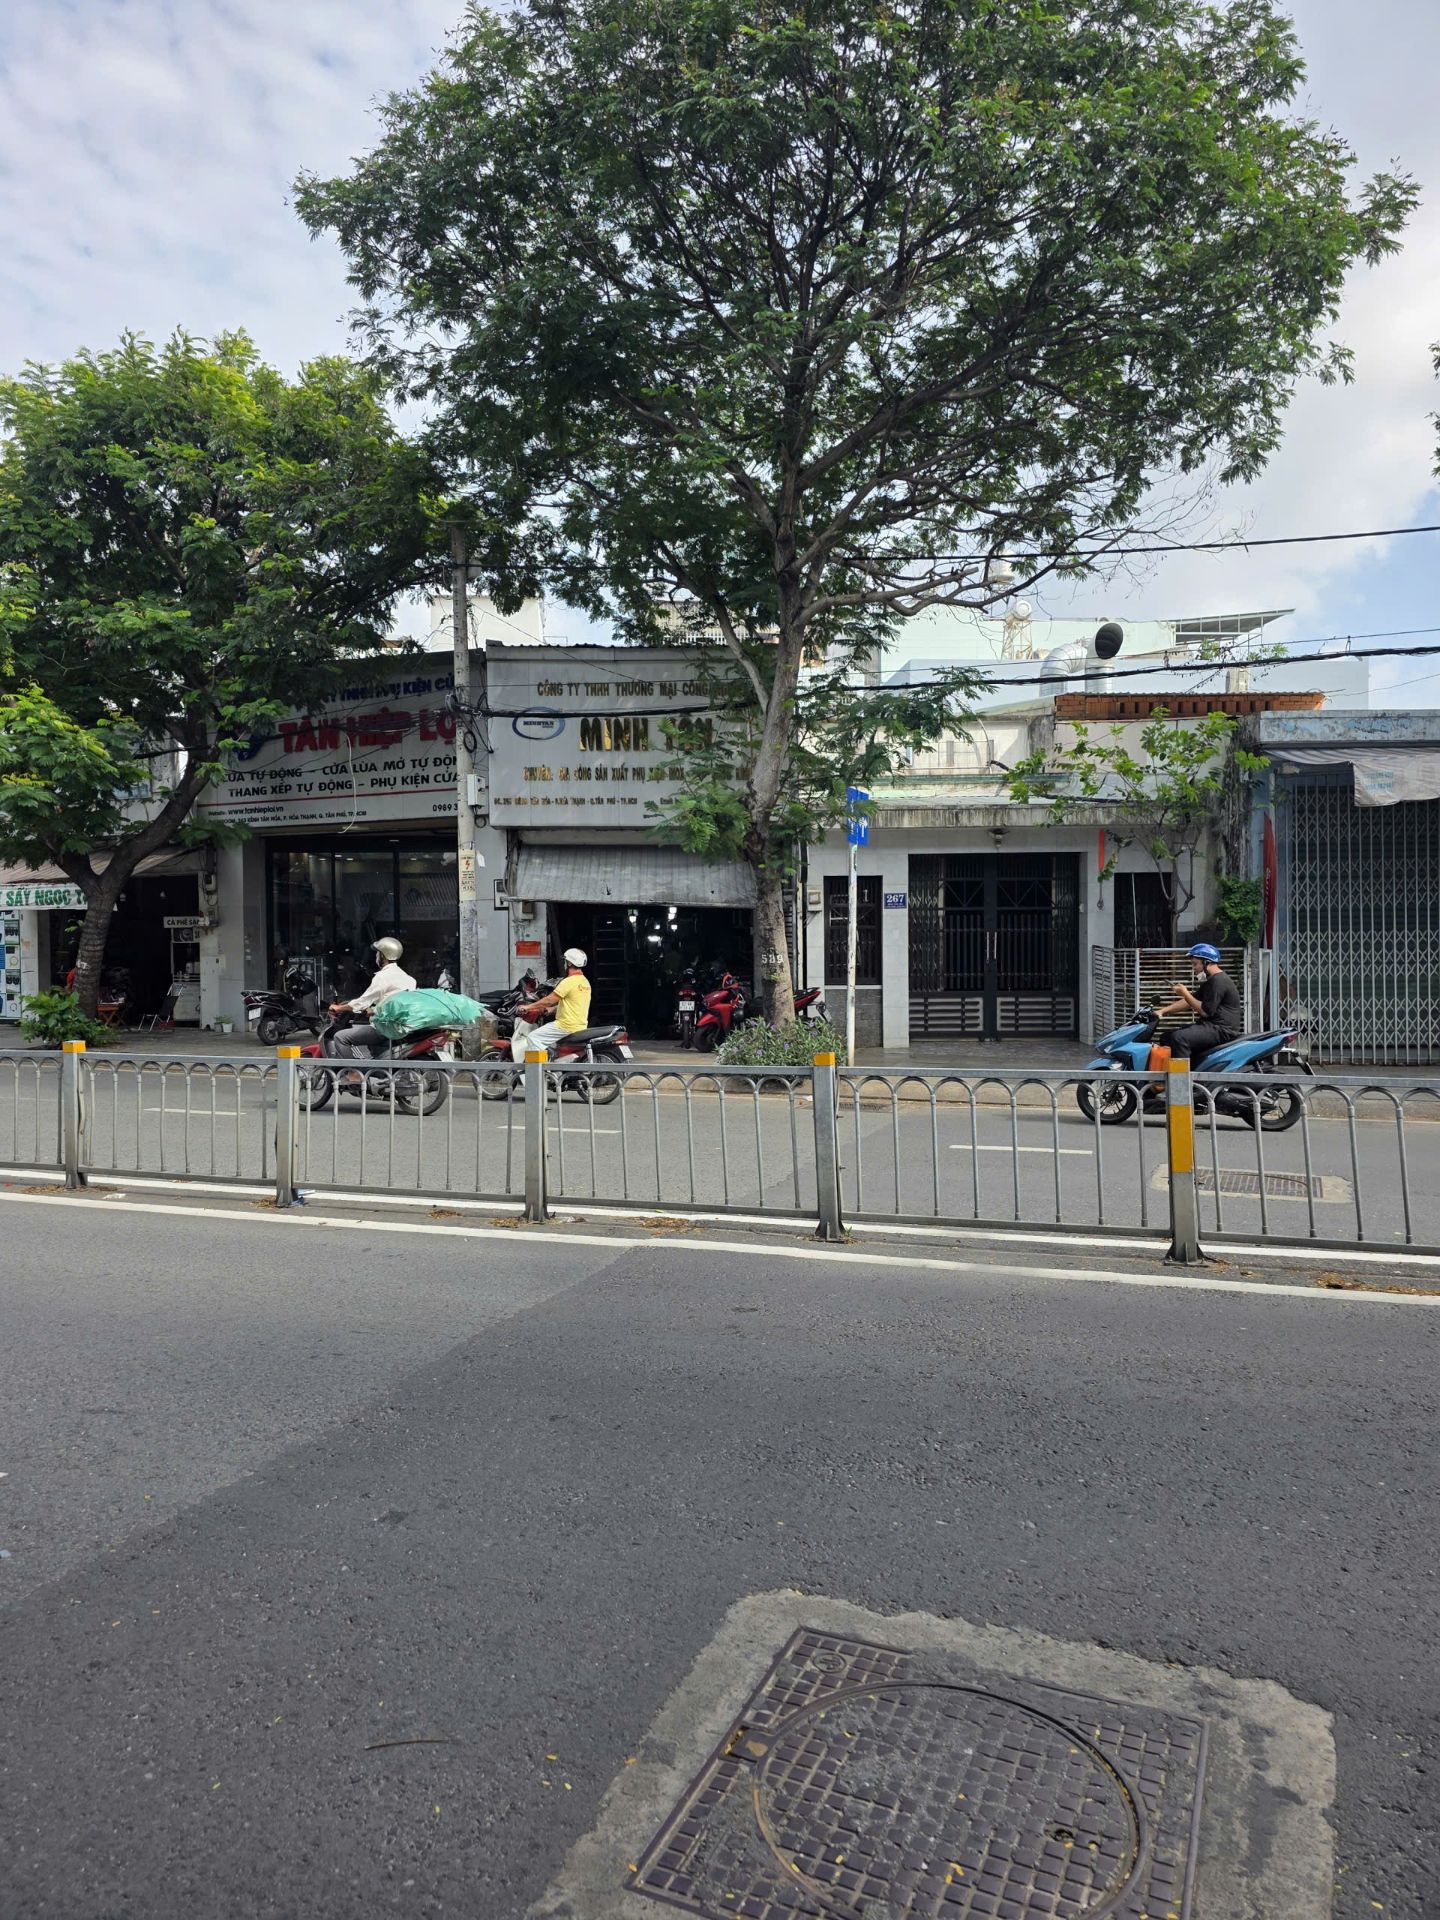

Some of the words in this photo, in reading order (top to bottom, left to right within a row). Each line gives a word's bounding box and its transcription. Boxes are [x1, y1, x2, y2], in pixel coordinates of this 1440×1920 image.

[403, 676, 432, 696] KIỆN
[434, 672, 455, 690] CỬ
[536, 678, 564, 696] CÔNG
[567, 682, 580, 696] TY
[585, 682, 610, 696] TNHH
[615, 680, 655, 696] THƯƠNG
[660, 681, 677, 699] MẠI
[278, 715, 340, 753] TÂN
[578, 716, 649, 752] MINH
[250, 769, 266, 783] TỰ
[269, 767, 303, 782] ĐỘNG
[322, 762, 348, 775] CỬA
[383, 757, 406, 771] MỞ
[410, 757, 430, 771] TỰ
[432, 754, 457, 769] ĐỘN
[595, 763, 608, 781] SẢN
[611, 762, 629, 781] XUẤT
[632, 767, 646, 784] PHỤ
[228, 784, 268, 798] THANG
[270, 781, 293, 795] XẾP
[296, 782, 314, 795] TỰ
[318, 778, 353, 794] ĐỘNG
[370, 777, 397, 790] PHỤ
[401, 772, 430, 788] KIỆN
[433, 803, 451, 813] 0989
[34, 888, 72, 908] NGỌC
[886, 894, 905, 903] 267
[177, 917, 188, 926] PHÊ
